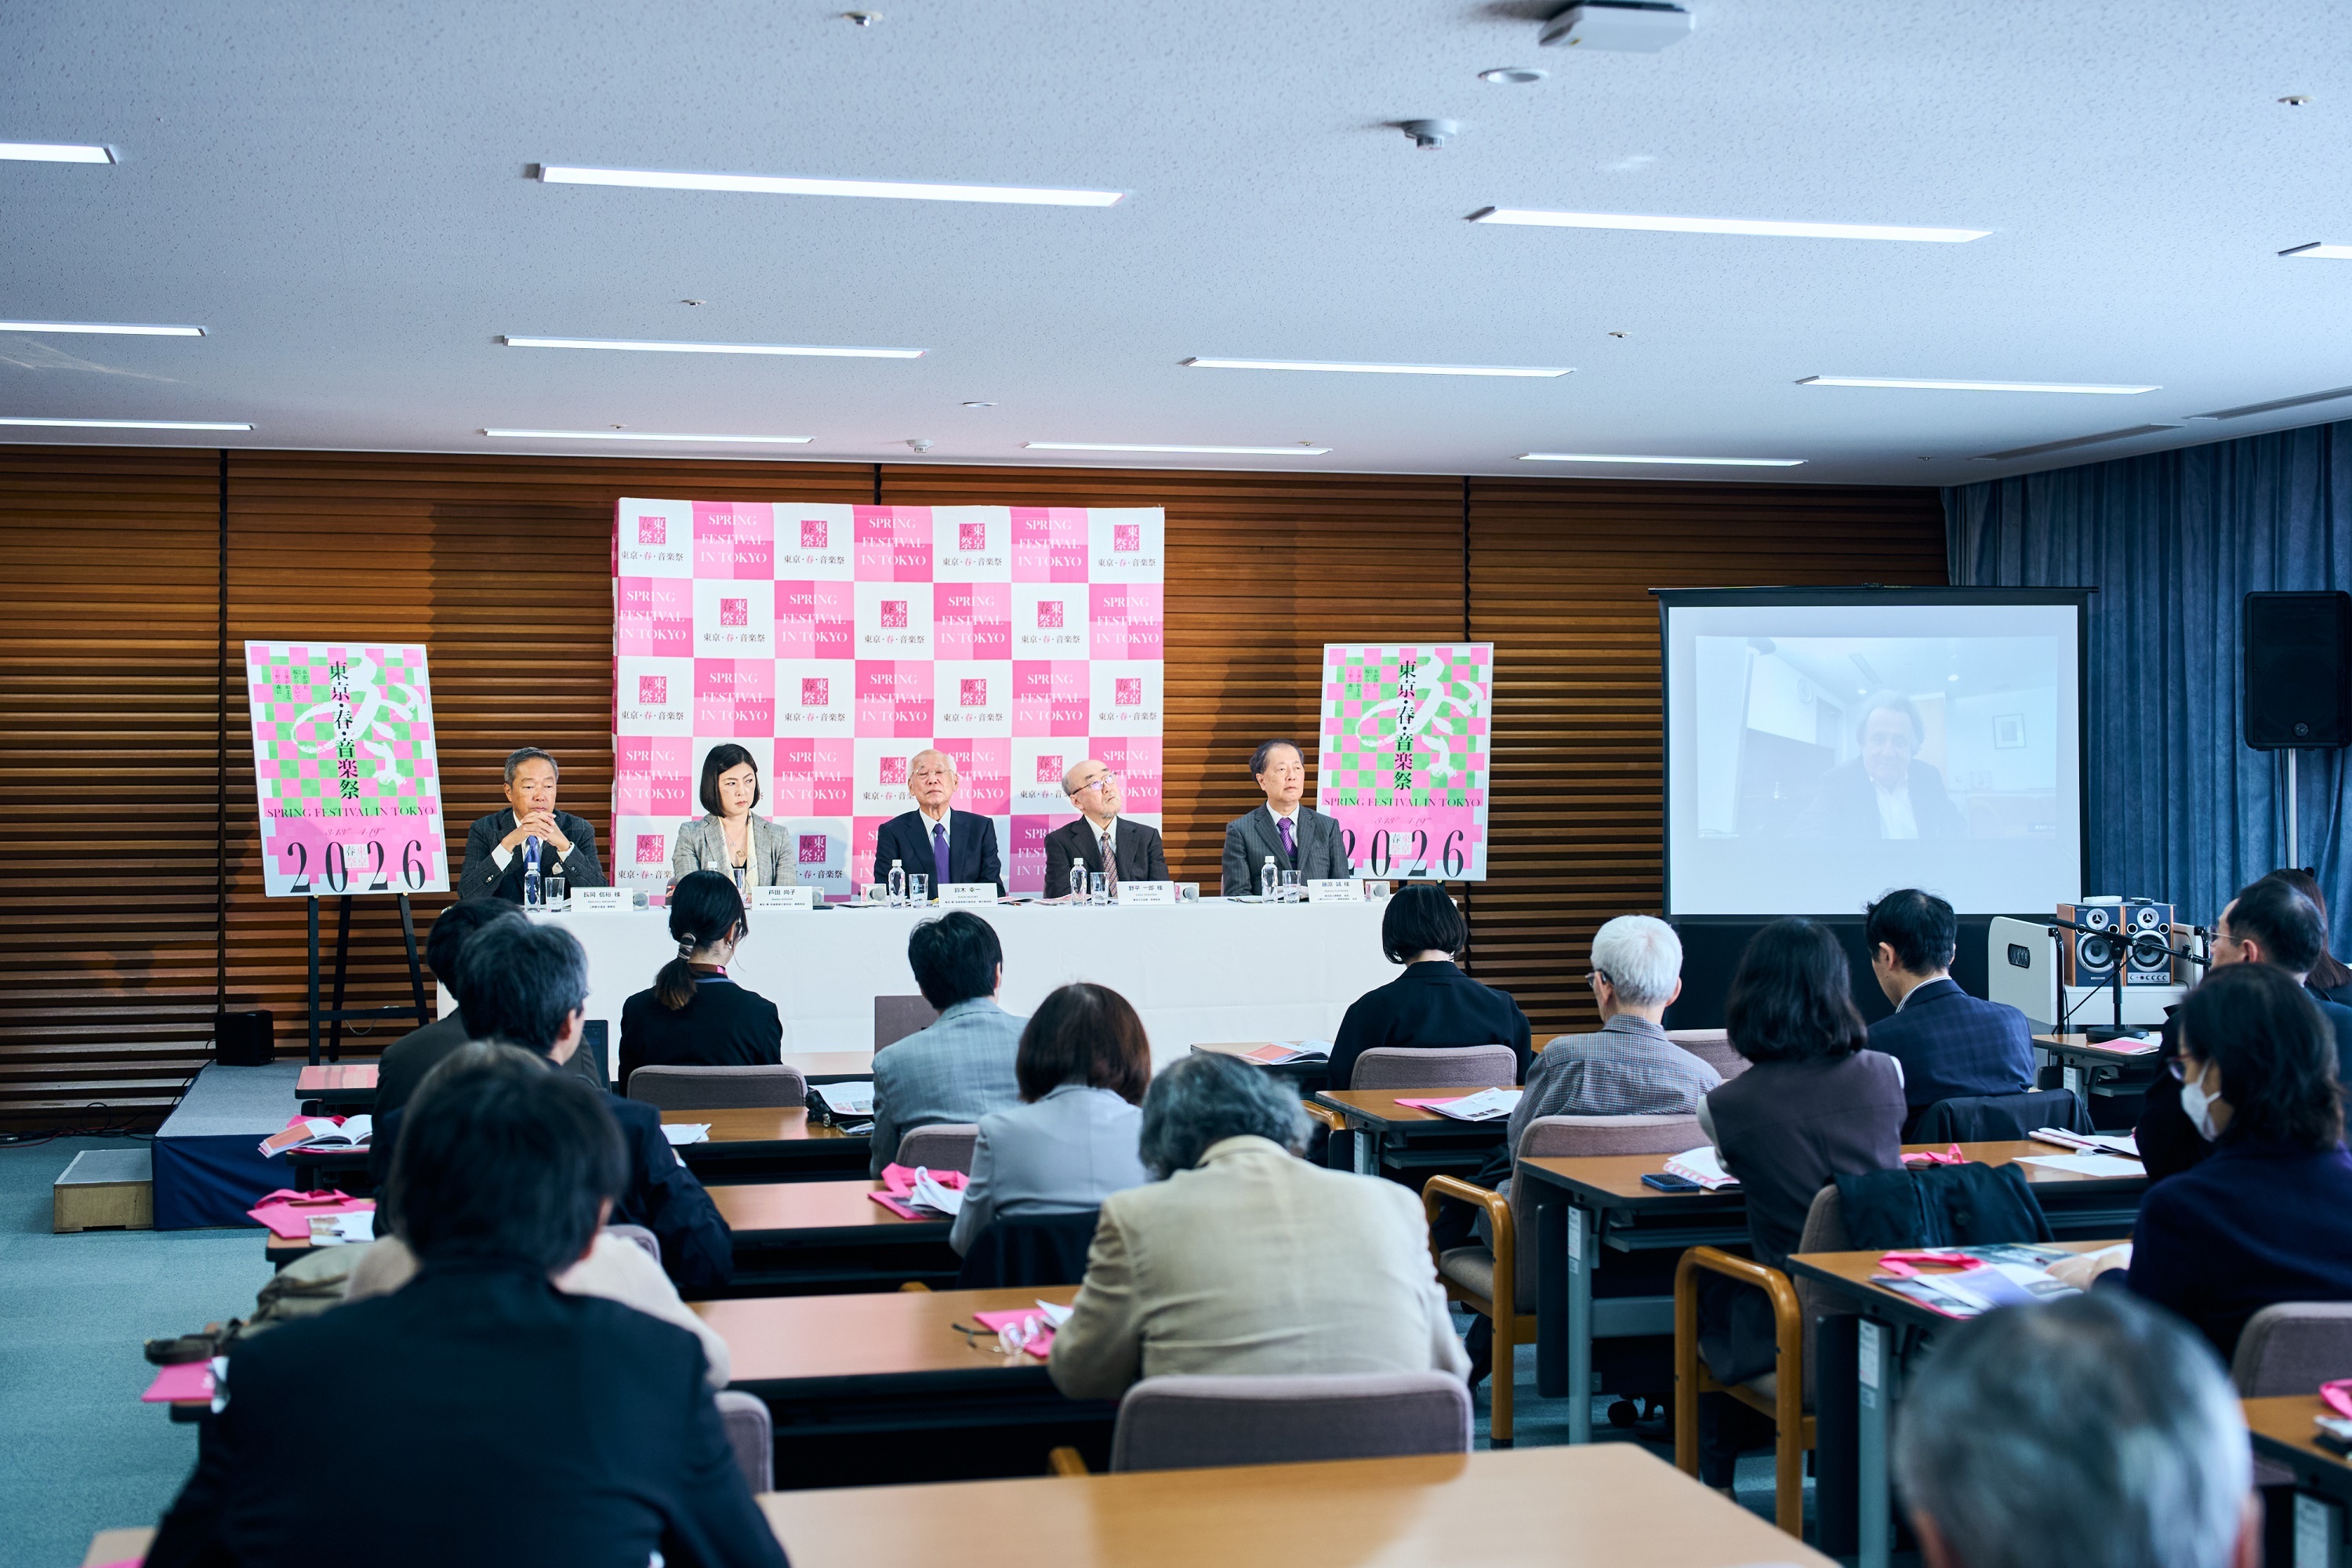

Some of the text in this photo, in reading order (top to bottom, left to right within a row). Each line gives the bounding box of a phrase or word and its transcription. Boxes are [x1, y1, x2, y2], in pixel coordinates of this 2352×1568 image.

[709, 514, 757, 526] SPRING
[869, 518, 916, 529] SPRING
[1025, 520, 1072, 530] SPRING
[702, 534, 765, 545] FESTIVAL
[862, 537, 925, 548] FESTIVAL
[1019, 539, 1080, 549] FESTIVAL
[701, 553, 767, 564] IN TOKYO
[862, 555, 926, 566] IN TOKYO
[1018, 557, 1082, 567] IN TOKYO
[626, 590, 675, 602] SPRING
[789, 594, 837, 605] SPRING
[948, 596, 994, 607] SPRING
[1104, 597, 1149, 607] SPRING
[620, 610, 684, 622] FESTIVAL
[783, 613, 846, 624] FESTIVAL
[942, 615, 1004, 626] FESTIVAL
[1098, 616, 1157, 626] FESTIVAL
[619, 629, 686, 640] IN TOKYO
[782, 632, 848, 642] IN TOKYO
[942, 633, 1005, 643] IN TOKYO
[1097, 633, 1159, 643] IN TOKYO
[710, 673, 757, 684] SPRING
[870, 674, 917, 684] SPRING
[1027, 674, 1073, 684] SPRING
[702, 692, 766, 702] FESTIVAL
[863, 693, 926, 703] FESTIVAL
[1020, 692, 1082, 702] FESTIVAL
[702, 710, 768, 720] IN TOKYO
[862, 711, 927, 721] IN TOKYO
[1020, 710, 1083, 720] IN TOKYO
[328, 661, 360, 800] 東京・春・音楽祭
[1393, 660, 1417, 790] 東京・春・音楽祭
[626, 750, 674, 761] SPRING
[789, 752, 837, 762] SPRING
[1103, 750, 1149, 761] SPRING
[619, 770, 684, 781] FESTIVAL
[782, 771, 845, 782] FESTIVAL
[958, 771, 1003, 782] STIVAL
[1113, 769, 1157, 779] TIVAL
[618, 789, 684, 799] IN TOKYO
[781, 789, 847, 800] IN TOKYO
[1120, 786, 1158, 797] OKYO
[1325, 797, 1480, 807] SPRING FESTIVAL IN TOKYO
[267, 806, 434, 818] SPRING FESTIVAL IN TOKYO
[287, 840, 426, 893] 2026
[1017, 866, 1030, 876] IN
[618, 869, 672, 879] 東京・春・音楽
